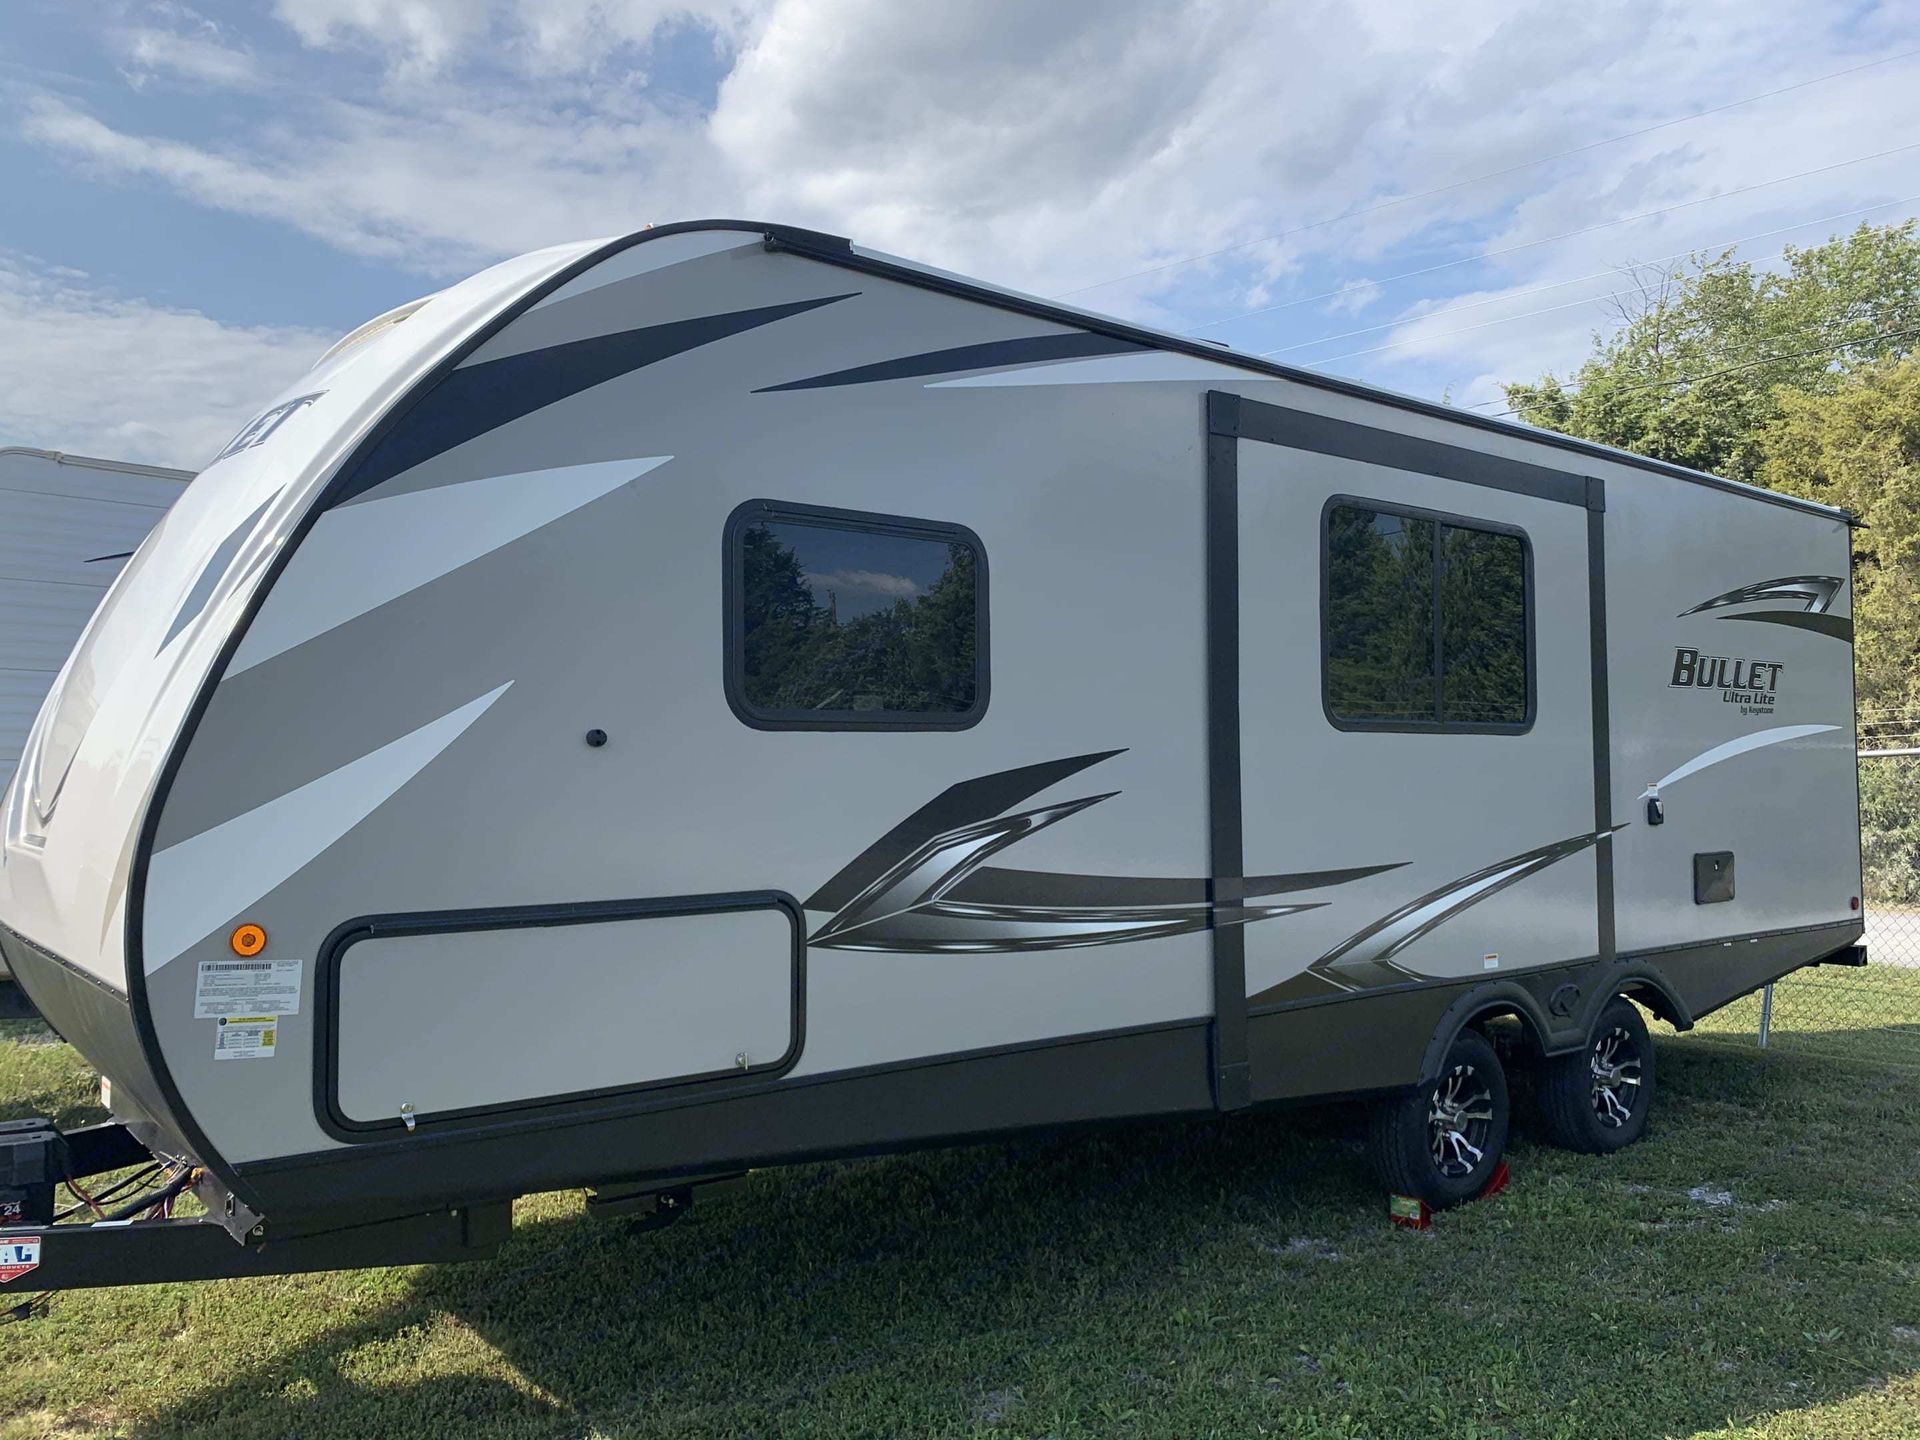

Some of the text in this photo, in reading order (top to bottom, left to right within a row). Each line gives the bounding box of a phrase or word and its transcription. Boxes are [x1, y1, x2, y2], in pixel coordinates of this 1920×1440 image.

[1667, 646, 1784, 693] BULLET
[1723, 691, 1775, 705] Ultra Lite
[1740, 705, 1748, 716] by
[3, 1204, 21, 1216] 24
